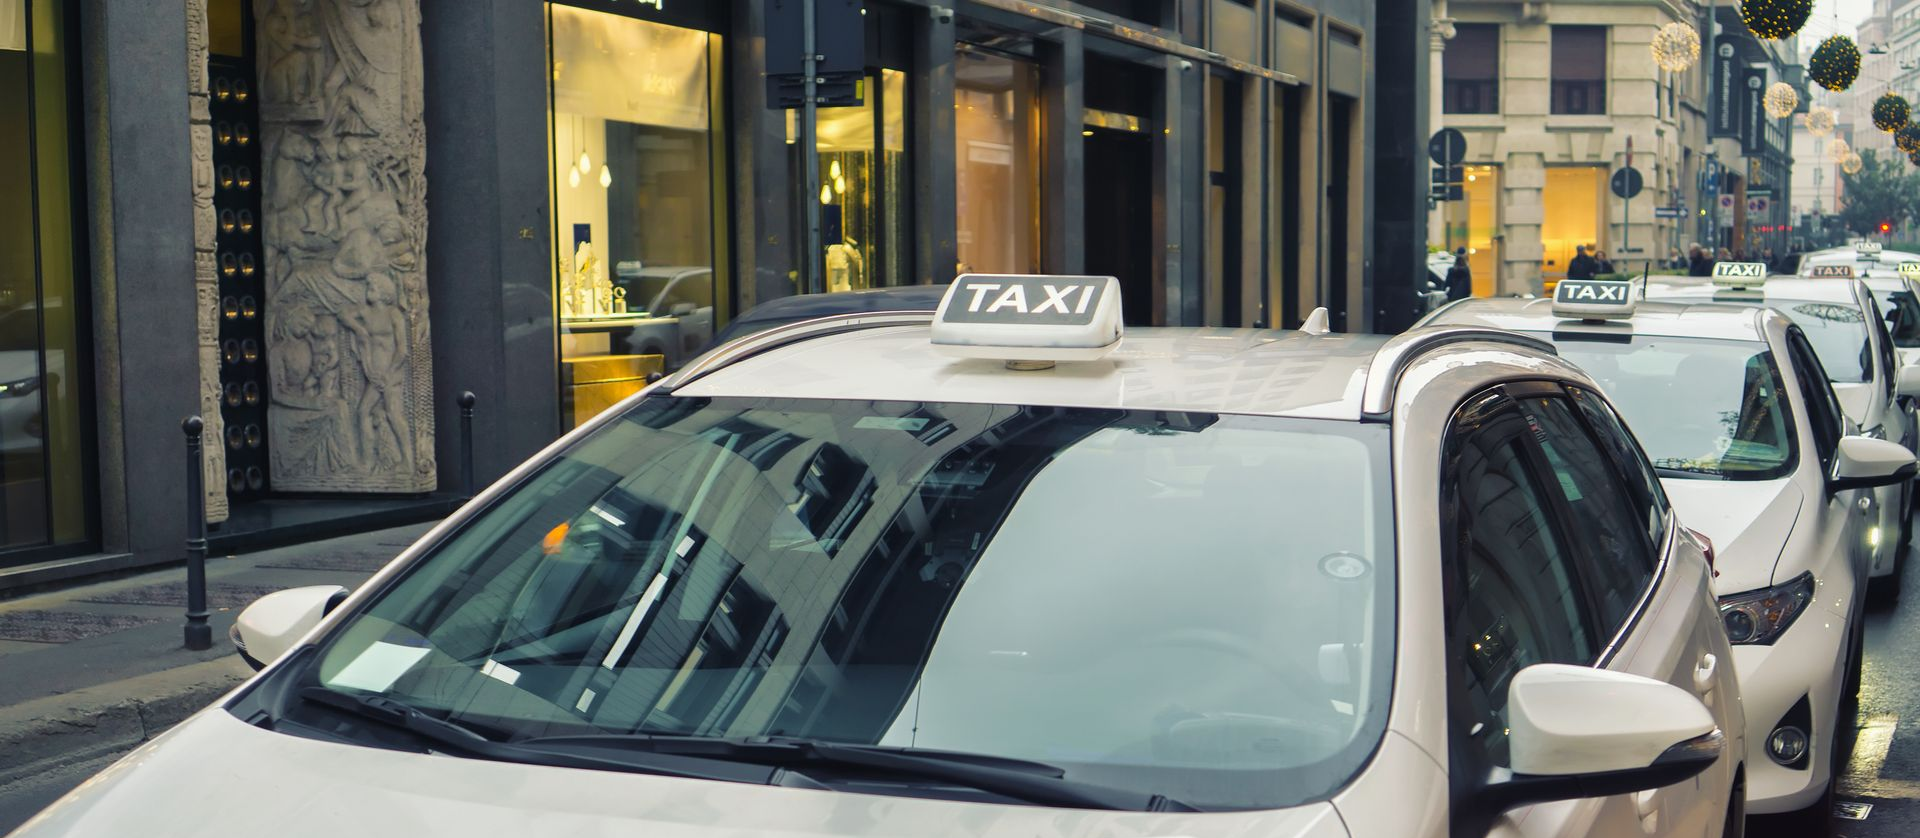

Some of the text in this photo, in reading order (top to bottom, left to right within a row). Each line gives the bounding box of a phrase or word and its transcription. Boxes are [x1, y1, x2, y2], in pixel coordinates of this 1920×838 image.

[1720, 264, 1760, 276] TAXI
[1815, 266, 1849, 275] TAXI
[966, 283, 1096, 314] TAXI
[1563, 284, 1626, 301] TAXI
